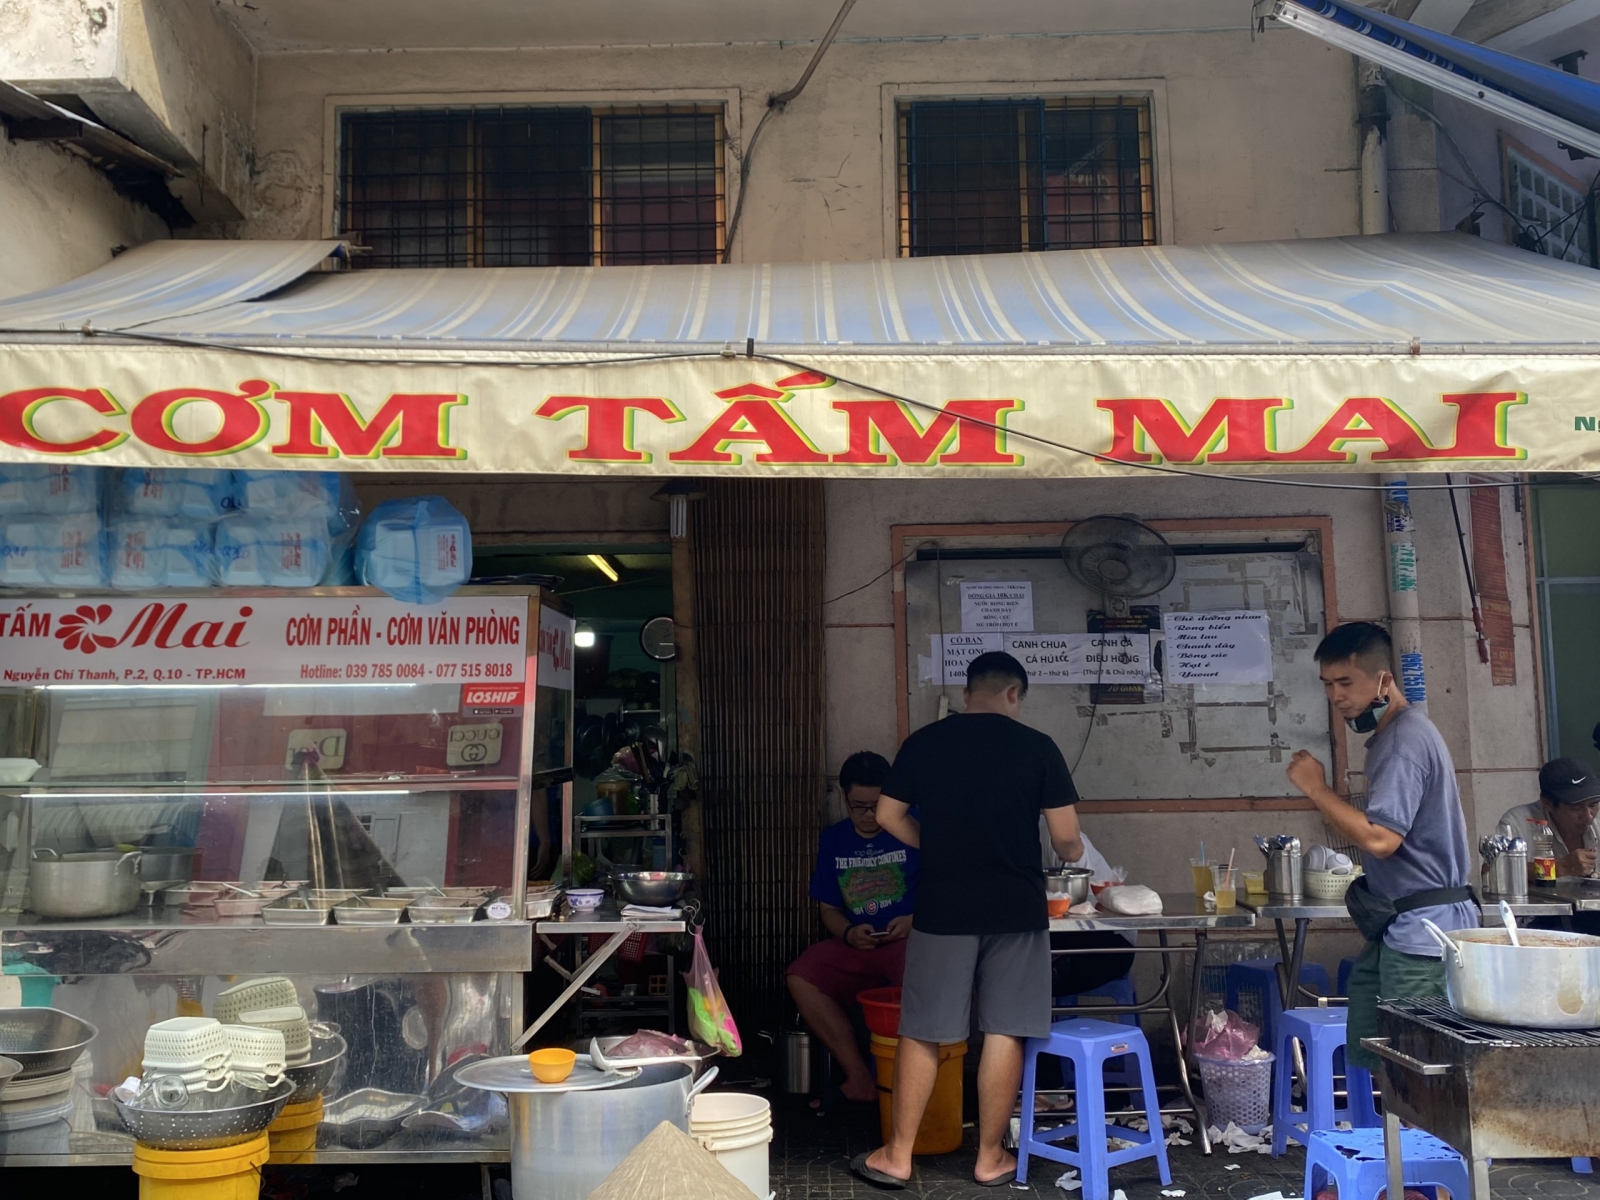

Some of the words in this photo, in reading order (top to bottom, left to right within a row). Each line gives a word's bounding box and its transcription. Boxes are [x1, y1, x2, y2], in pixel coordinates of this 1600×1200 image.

[0, 379, 469, 460] CƠM
[532, 370, 1026, 467] TẤM
[1095, 390, 1528, 464] MAI
[115, 602, 253, 649] Mai
[285, 613, 322, 646] CƠM
[326, 604, 371, 646] PHẦN
[387, 613, 423, 645] CƠM
[428, 611, 460, 645] VĂN
[465, 609, 520, 645] PHÒNG
[1012, 640, 1039, 649] CANH
[1040, 640, 1067, 649] CHUA
[1091, 639, 1118, 647] CANH
[1025, 653, 1038, 664] CÁ
[4, 667, 50, 682] Nguyễn
[54, 668, 74, 680] Chí
[78, 669, 120, 682] Thanh,
[124, 669, 149, 682] P.2,
[153, 669, 183, 681] Q.10
[196, 668, 246, 680] TP.HCM
[300, 664, 342, 679] Hotline:
[346, 664, 366, 678] 039
[371, 664, 392, 678] 785
[396, 663, 425, 678] 0084
[436, 663, 457, 677] 077
[461, 663, 481, 677] 515
[485, 663, 512, 677] 8018
[466, 691, 520, 704] LOSHIP
[835, 857, 848, 869] THE
